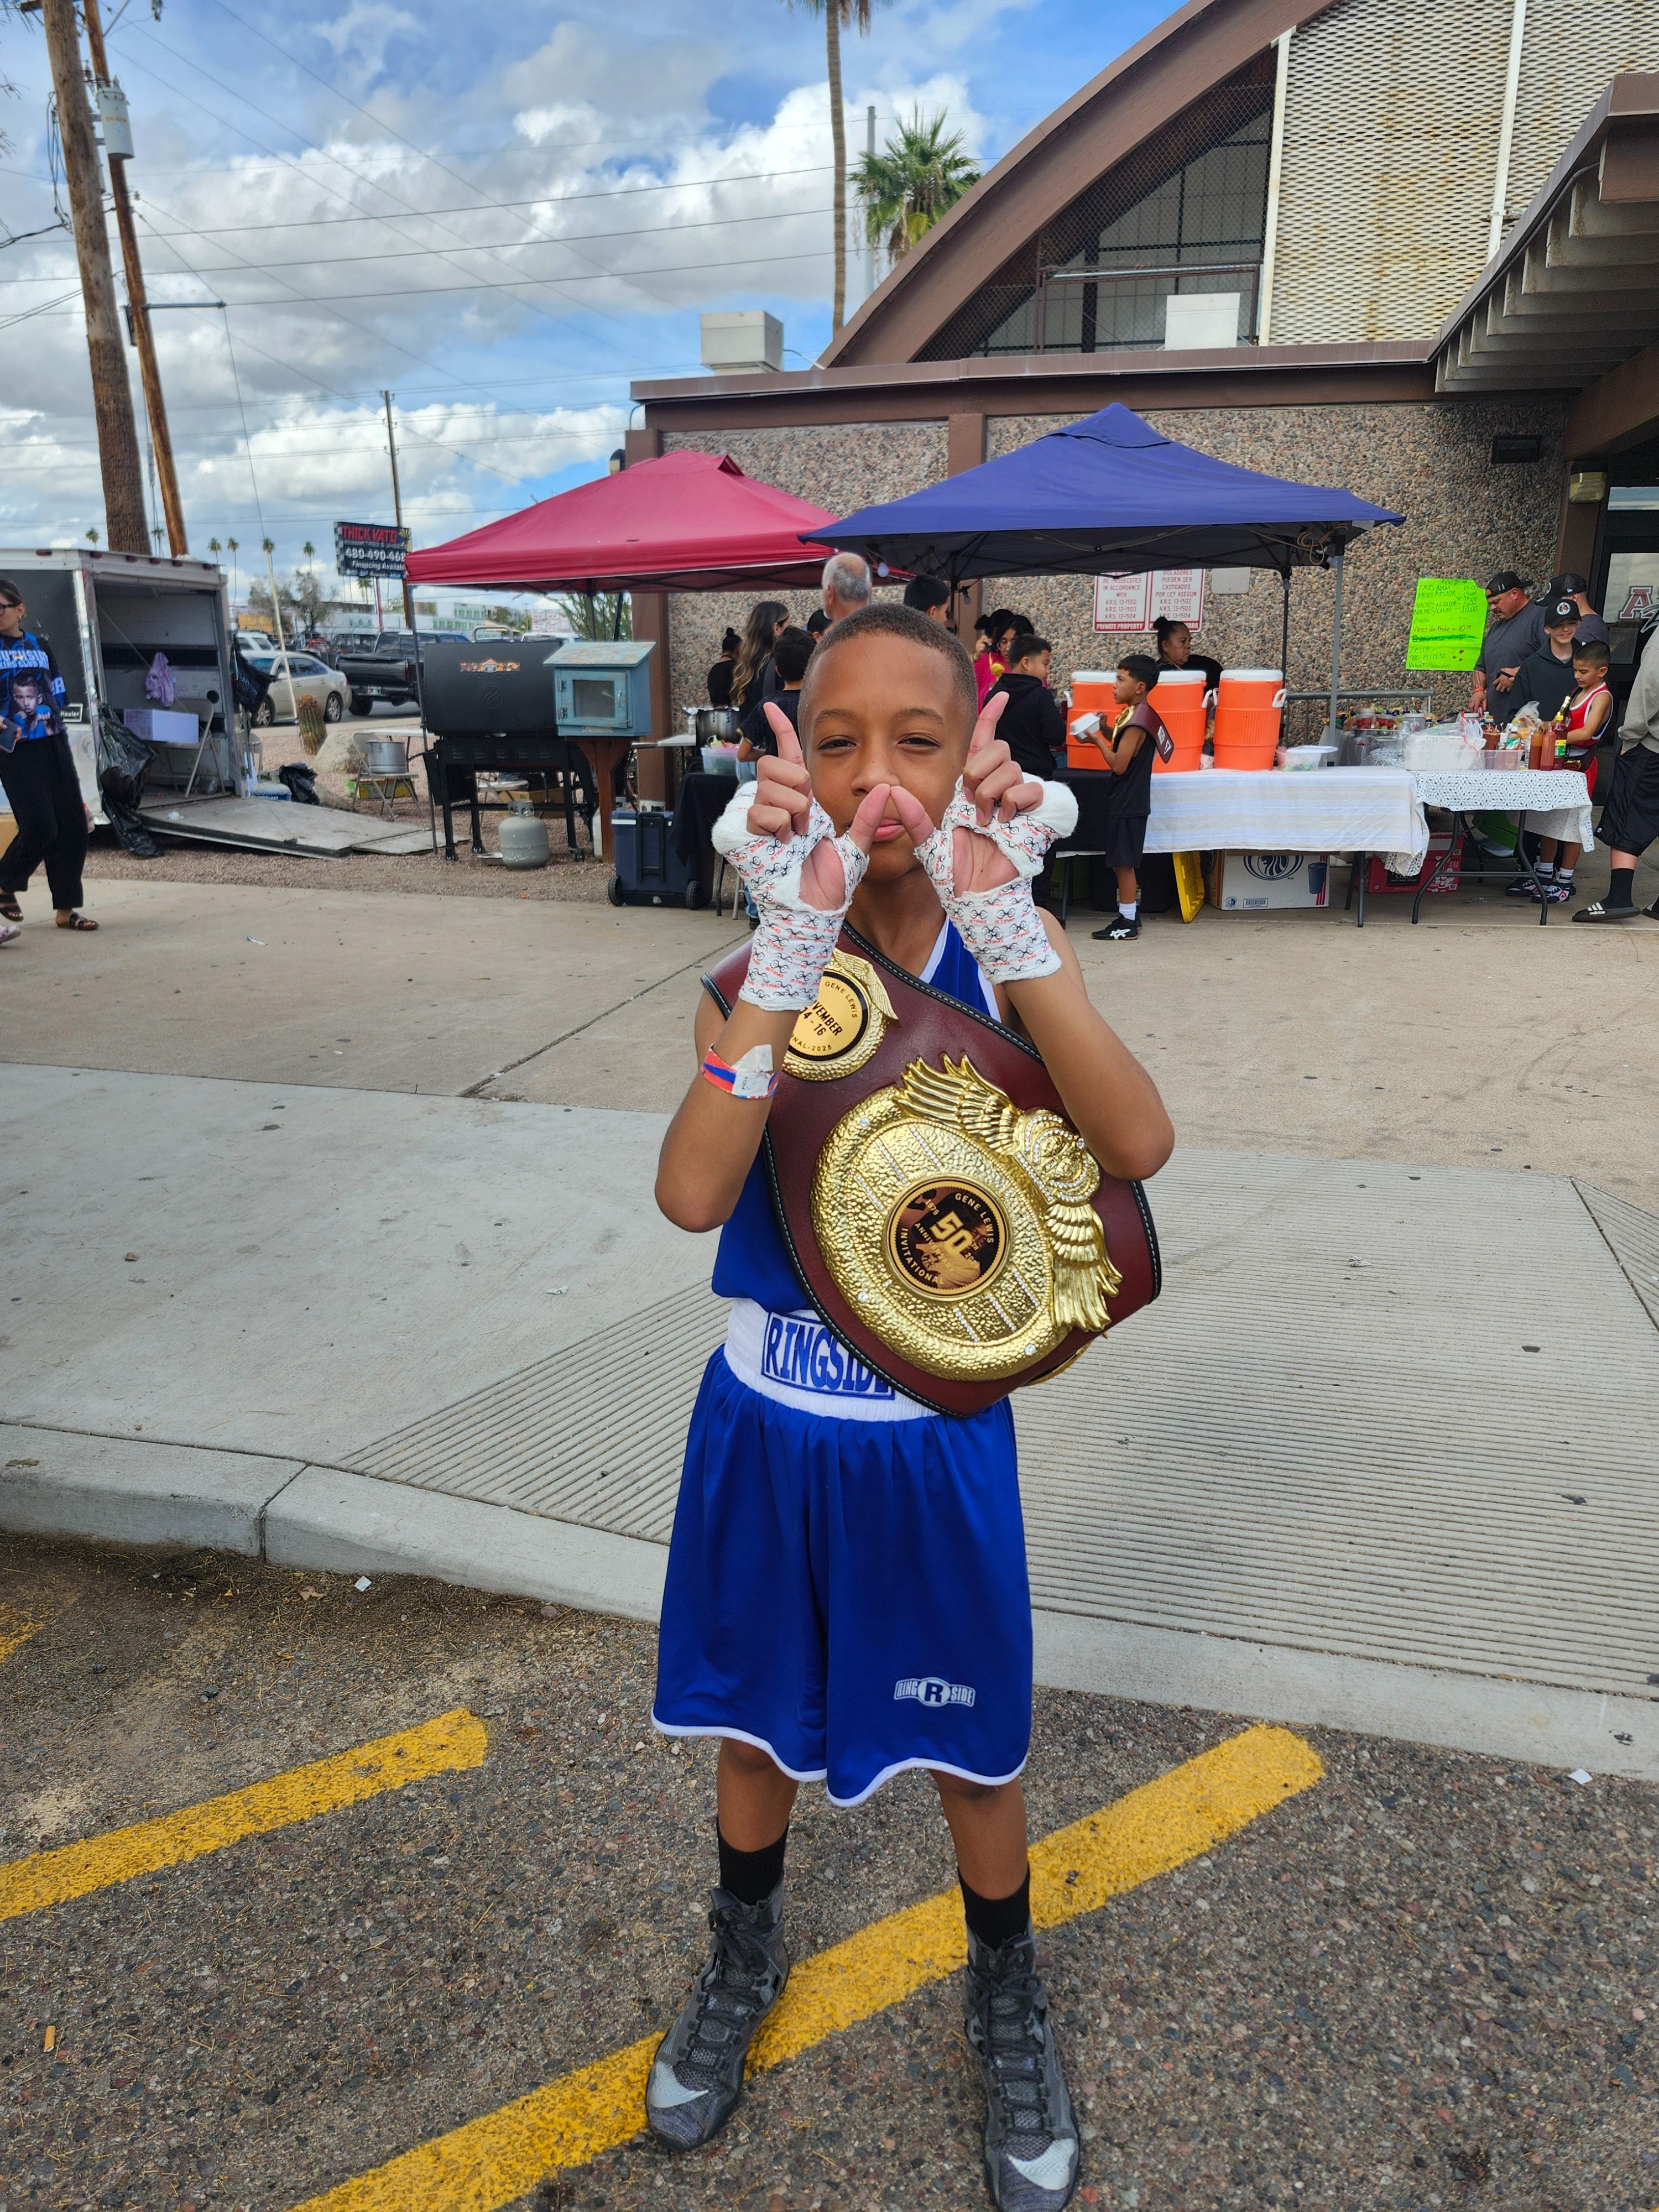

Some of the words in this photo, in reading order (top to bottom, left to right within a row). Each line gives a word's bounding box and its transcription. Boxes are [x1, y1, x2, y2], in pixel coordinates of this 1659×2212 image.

[342, 525, 371, 540] THICK
[373, 528, 397, 543] VATO
[352, 560, 380, 571] Financing
[1021, 823, 1039, 836] STING
[1019, 842, 1034, 855] STING
[1012, 931, 1030, 940] STING
[1018, 954, 1036, 962] STING
[765, 967, 784, 978] STING
[825, 981, 846, 994] GENE
[846, 994, 858, 1018] LEWIS
[801, 1007, 812, 1019] 14
[813, 1024, 827, 1036] 16
[812, 1000, 843, 1036] VEMBER
[925, 1199, 940, 1215] 1975
[954, 1193, 981, 1211] GENE
[979, 1211, 994, 1243] LEWIS
[929, 1210, 973, 1255] 50
[915, 1222, 954, 1272] ANNIVERSARY
[900, 1228, 945, 1285] INVITATIONAL
[896, 1681, 918, 1697] RING
[951, 1686, 974, 1704] SIDE
